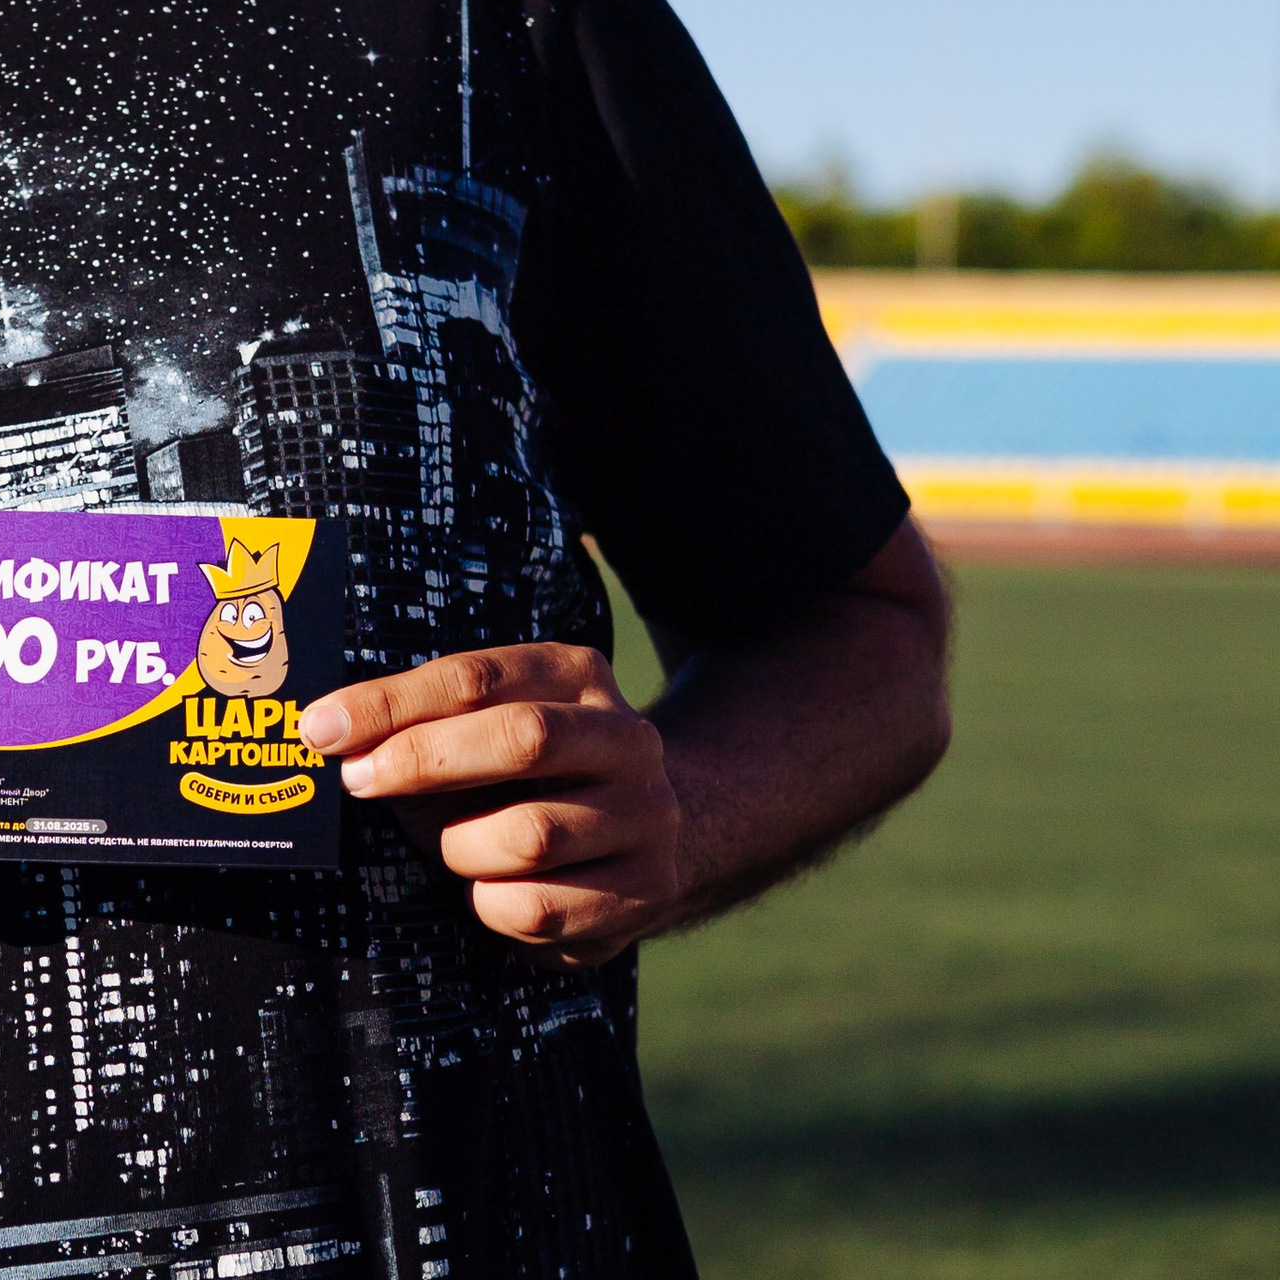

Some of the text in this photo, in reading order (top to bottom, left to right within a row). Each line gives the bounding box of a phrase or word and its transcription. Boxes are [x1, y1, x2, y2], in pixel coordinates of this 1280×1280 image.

[75, 639, 176, 686] РУБ.
[170, 741, 325, 768] КАРТОШКА
[22, 788, 50, 797] Двор"
[189, 779, 308, 805] СОБЕРИ И СЪЕШЬ
[12, 822, 26, 830] до
[33, 821, 90, 831] 31.08.2025
[23, 835, 36, 843] НА
[38, 835, 87, 845] ДЕНЕЖНЫЕ
[88, 837, 136, 846] СРЕДСТВА.
[137, 838, 149, 846] НЕ
[150, 838, 195, 847] ЯВЛЯЕТСЯ
[196, 839, 250, 848] ПУБЛИЧНОЙ
[251, 841, 293, 849] ОФЕРТОЙ
